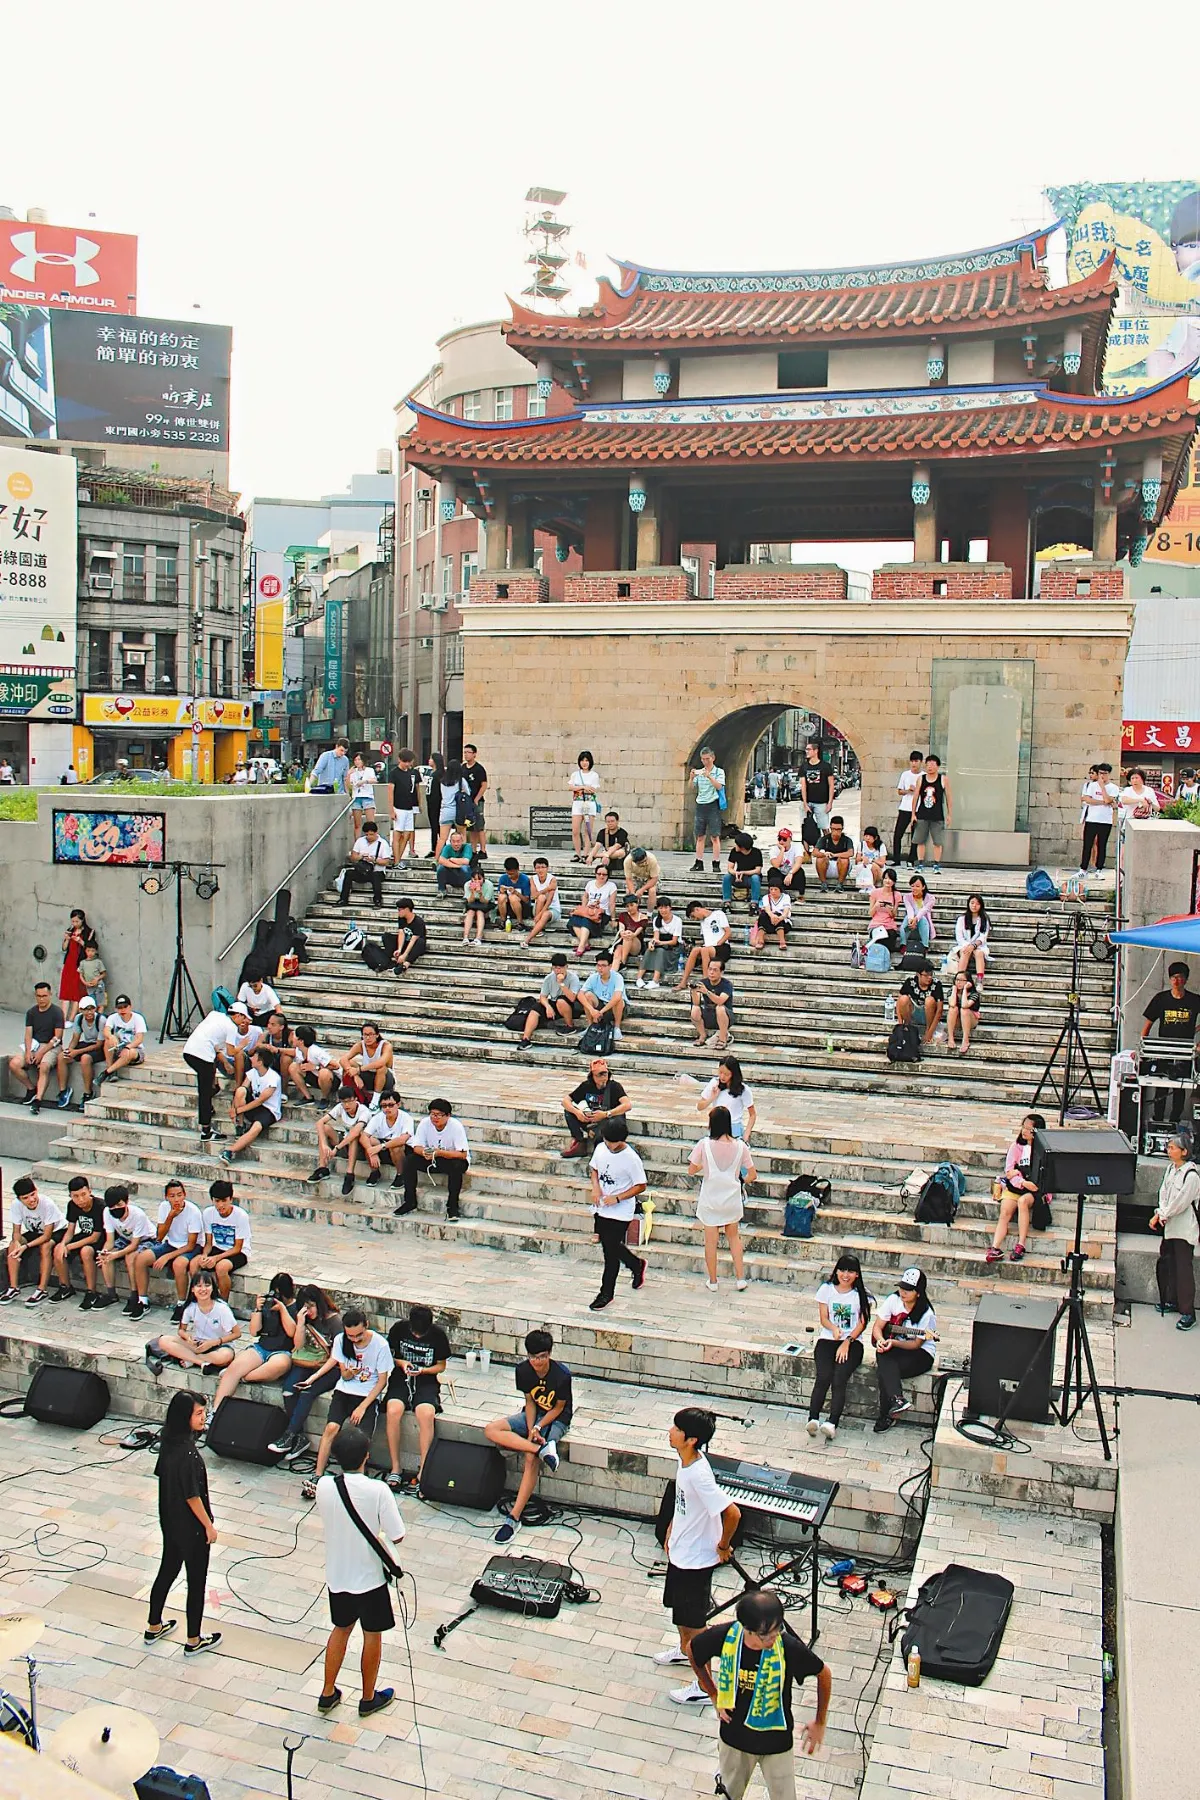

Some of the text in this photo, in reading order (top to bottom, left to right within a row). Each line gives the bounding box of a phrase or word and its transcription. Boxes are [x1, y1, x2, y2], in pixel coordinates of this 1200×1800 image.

[1118, 320, 1150, 332] 車位
[97, 326, 200, 350] 幸福的約定
[1108, 334, 1149, 346] 成貸款
[96, 345, 199, 370] 簡單的初衷
[104, 426, 220, 443] 東門國小旁 535 2328
[0, 550, 48, 569] 綠園道
[0, 571, 47, 588] -8888
[530, 1385, 555, 1411] Cal
